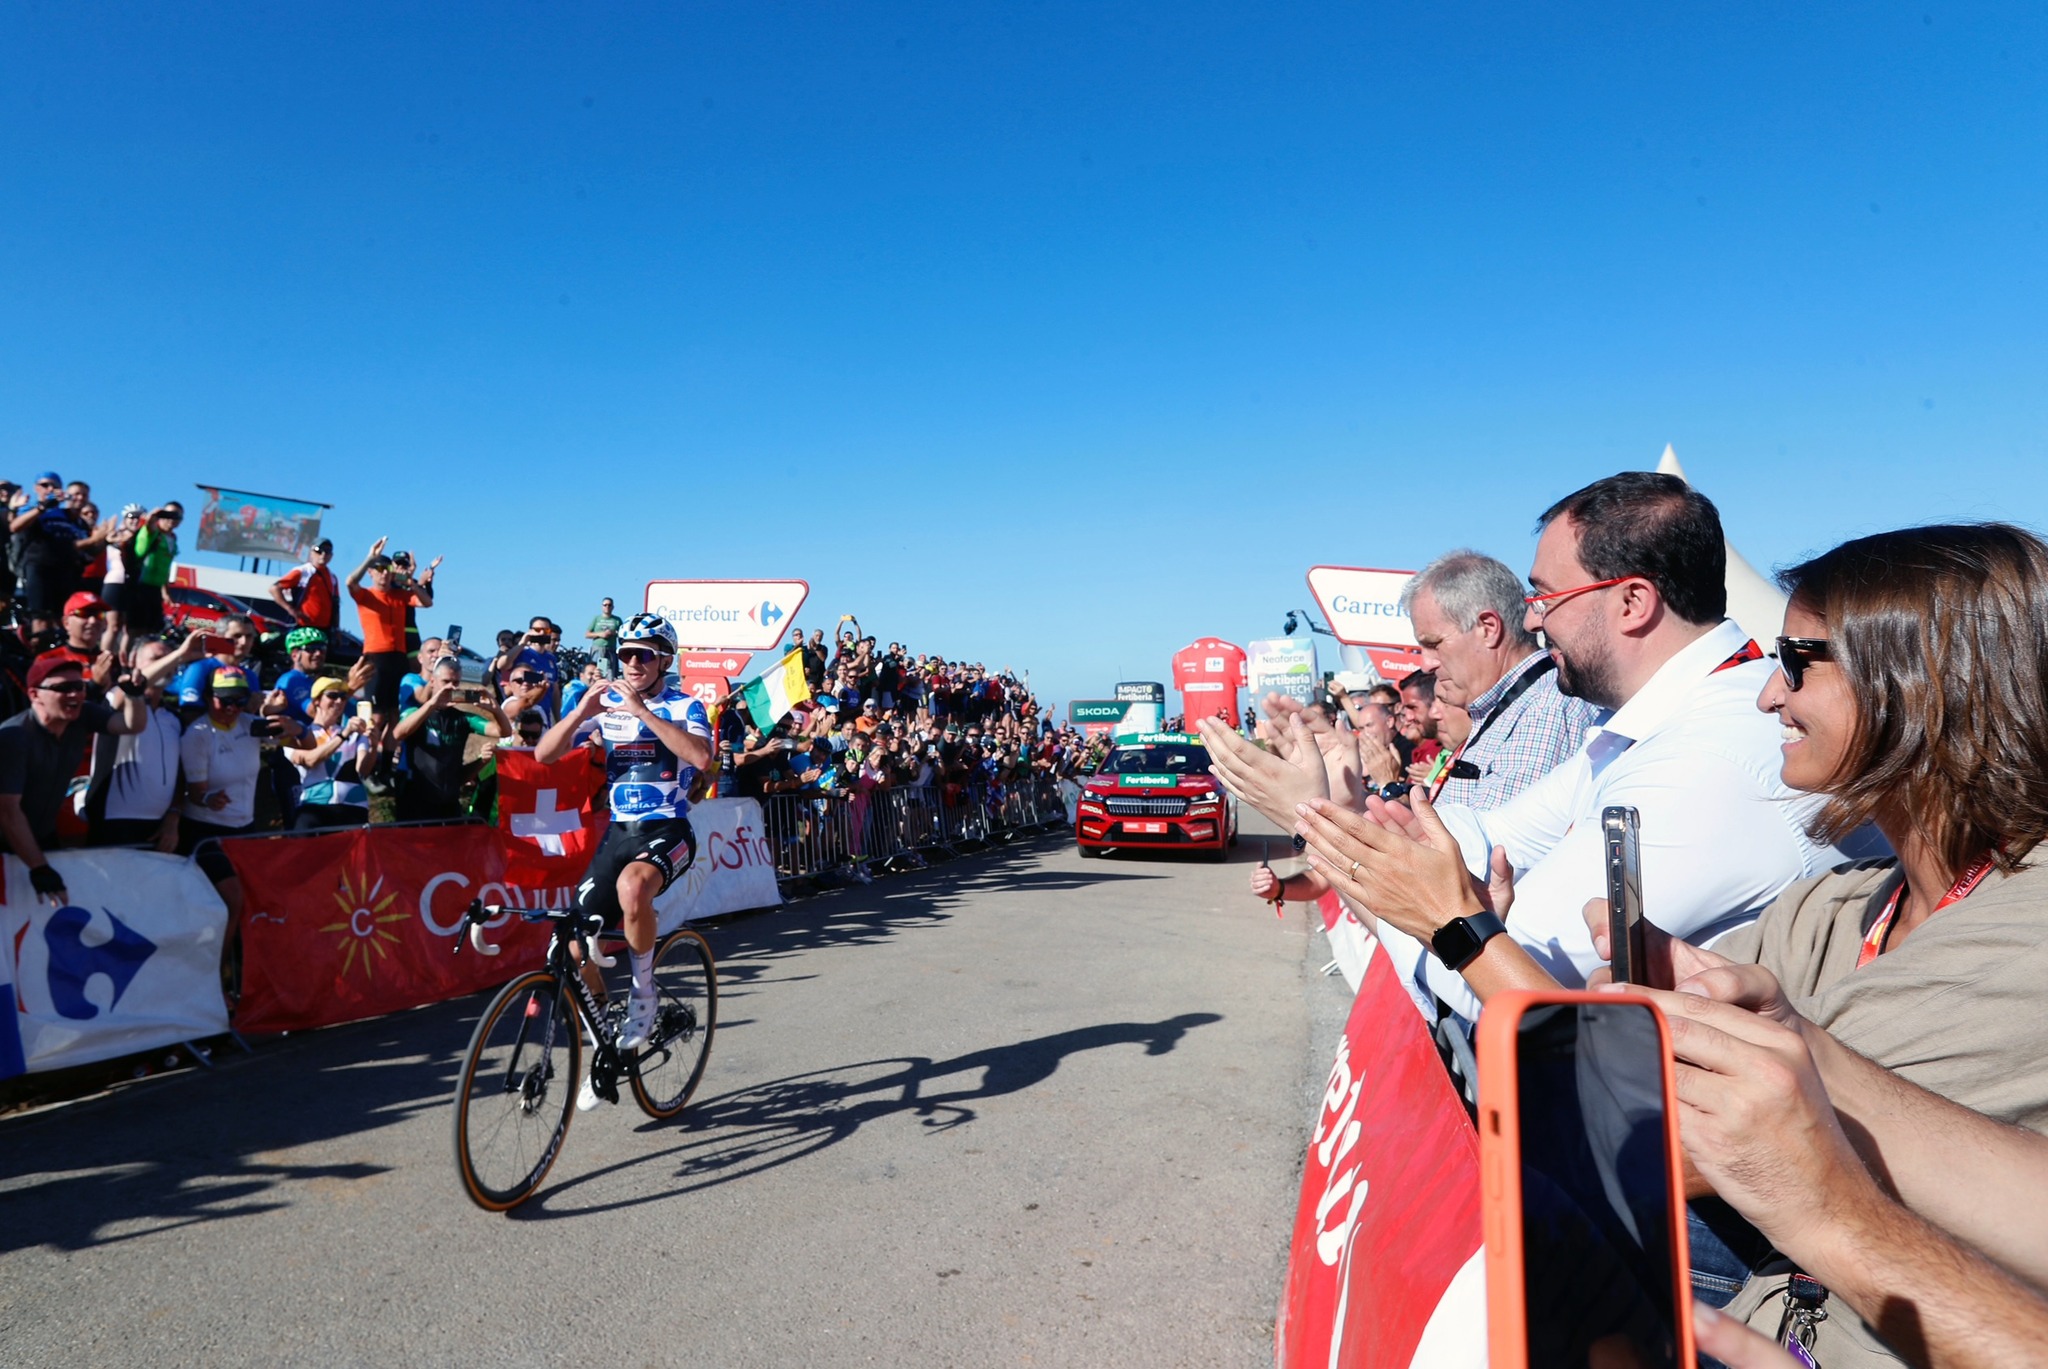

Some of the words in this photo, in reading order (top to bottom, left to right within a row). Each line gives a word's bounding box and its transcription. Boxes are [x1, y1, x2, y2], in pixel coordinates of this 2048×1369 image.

[656, 605, 740, 621] Carrefour
[1262, 655, 1305, 663] Neoforce
[686, 660, 720, 669] Carrefour
[1259, 674, 1310, 686] Fertiberia
[692, 683, 716, 704] 25
[1117, 685, 1152, 693] IMPACTO
[1285, 685, 1311, 694] TECH
[1137, 733, 1187, 743] Fertiberia
[1125, 776, 1170, 784] Fertiberia
